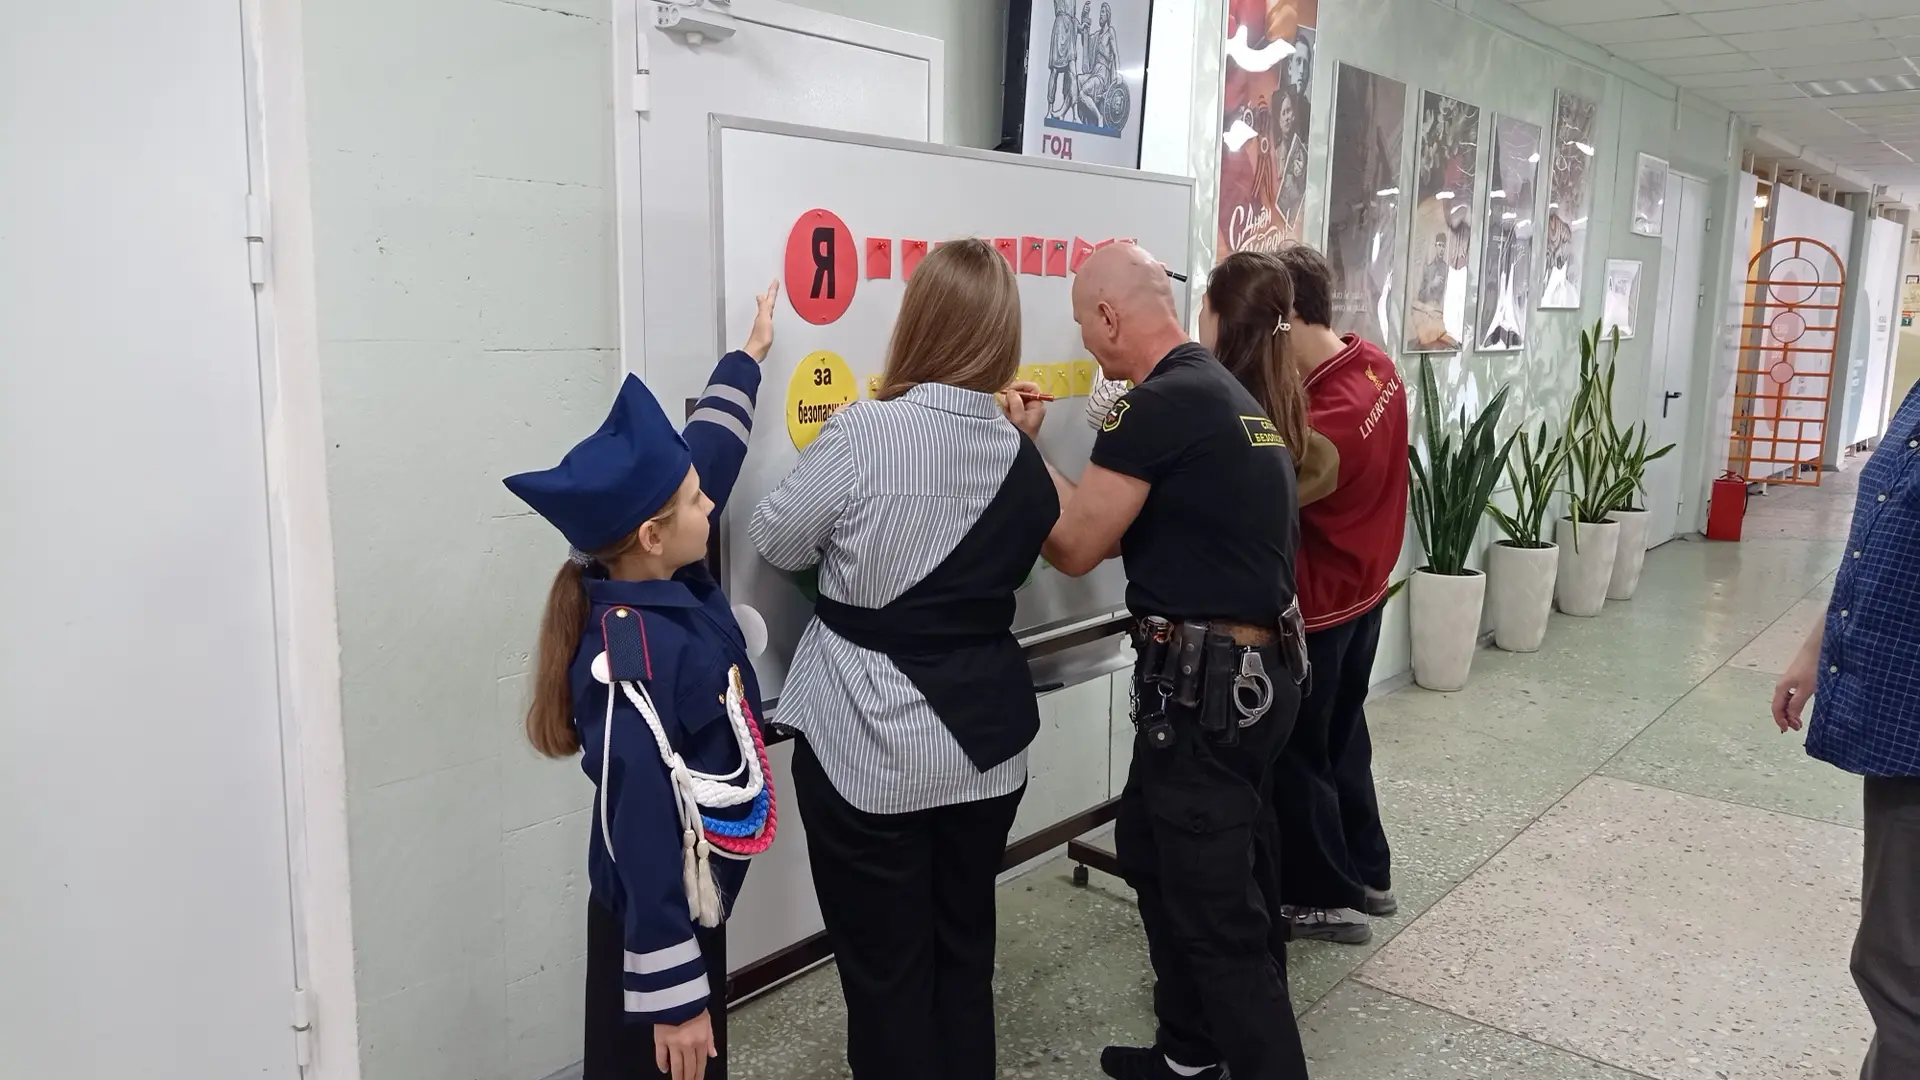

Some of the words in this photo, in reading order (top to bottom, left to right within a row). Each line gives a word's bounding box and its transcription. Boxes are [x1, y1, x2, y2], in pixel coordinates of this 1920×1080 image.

[1042, 134, 1073, 160] ГОД
[810, 227, 835, 299] Я
[814, 368, 832, 386] за
[1359, 377, 1399, 440] LIVERPOOL
